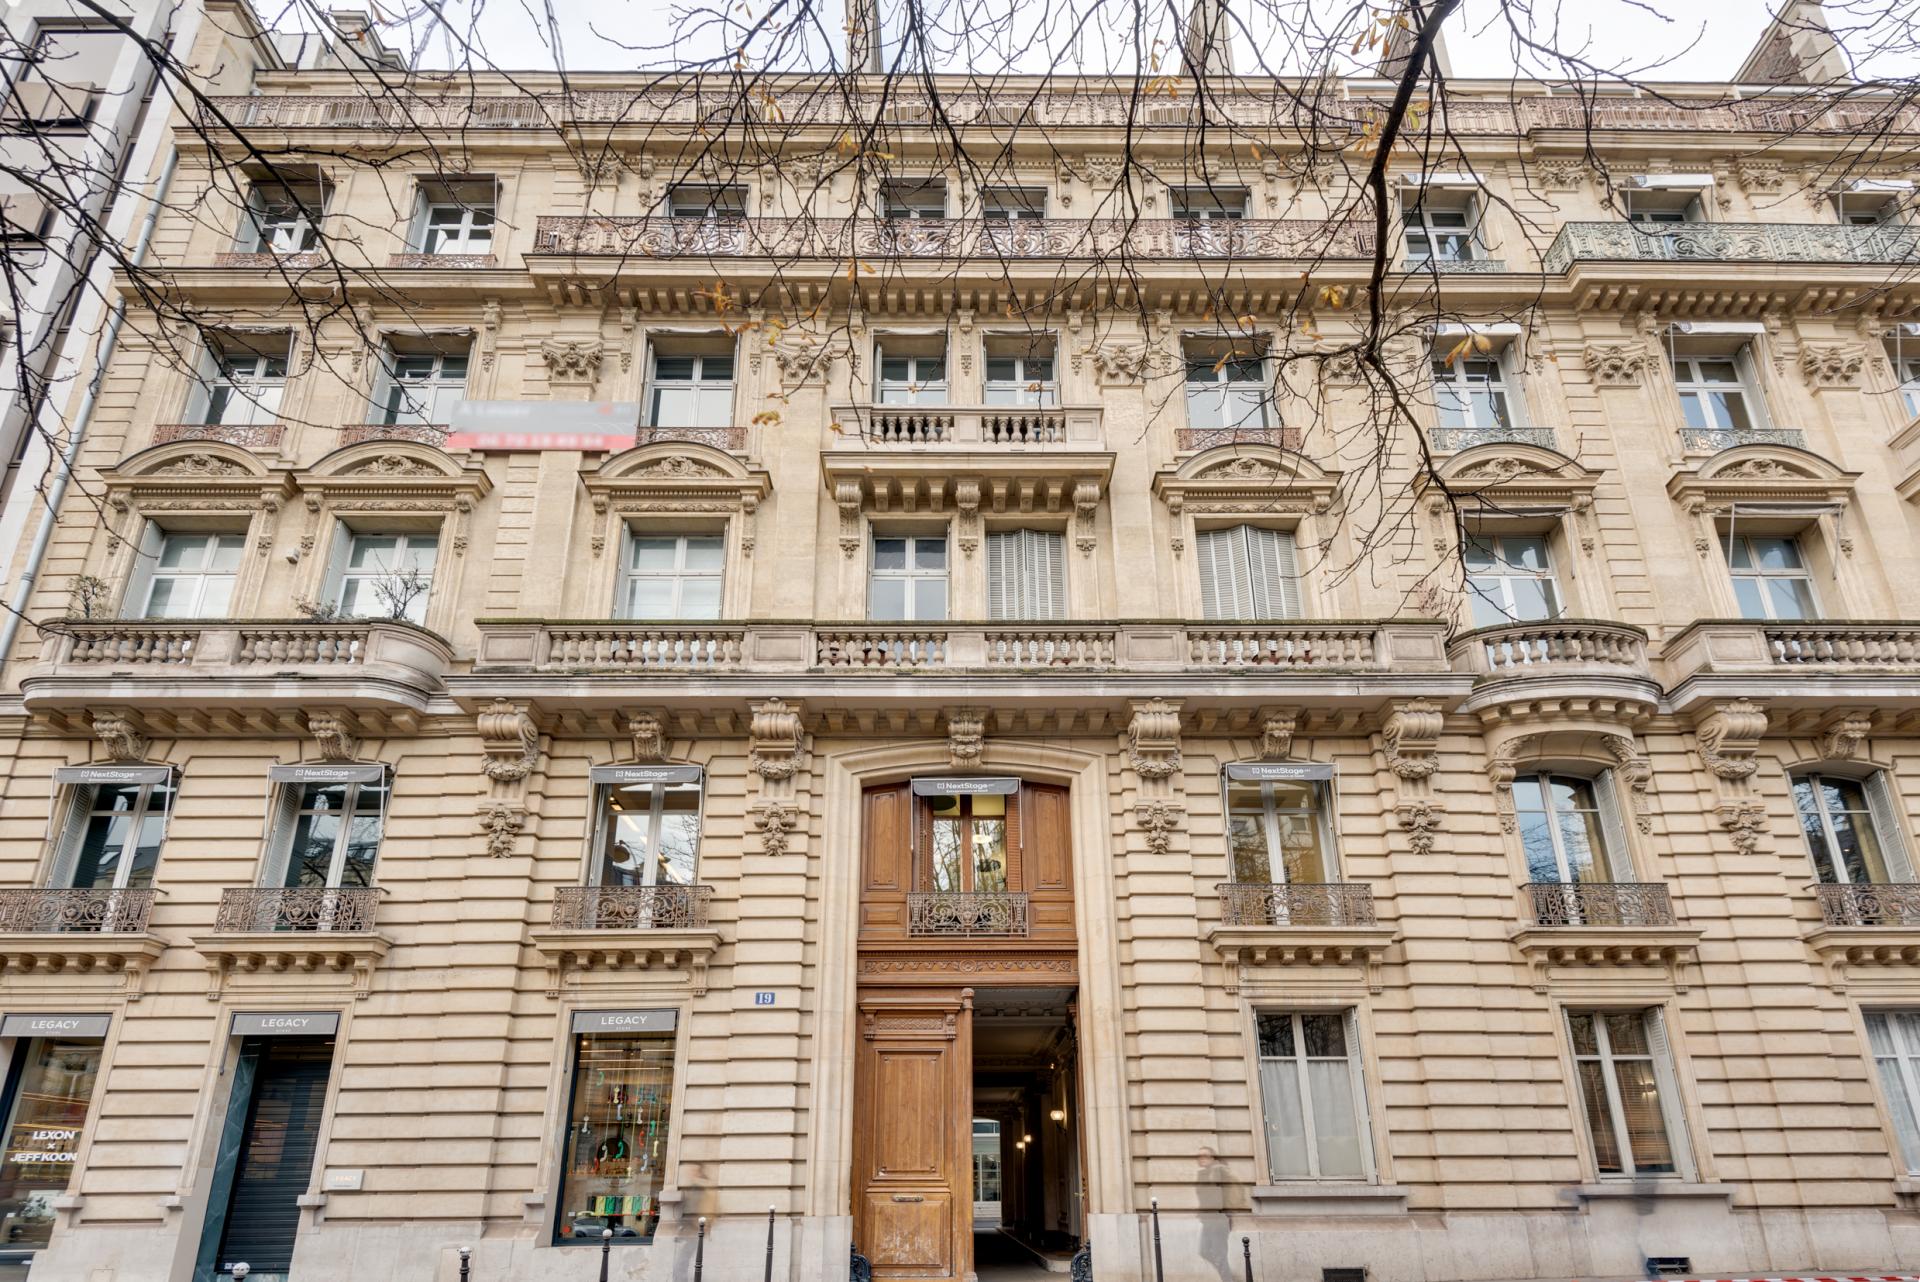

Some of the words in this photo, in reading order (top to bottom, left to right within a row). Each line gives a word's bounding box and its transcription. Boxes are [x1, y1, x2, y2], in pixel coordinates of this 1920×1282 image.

[90, 770, 135, 778] NextStage
[304, 769, 349, 777] NextStage
[624, 770, 668, 778] NextStage
[1261, 767, 1304, 775] NextStage
[946, 782, 988, 790] NextStage
[759, 993, 772, 1004] 19
[31, 1020, 80, 1029] LEGACY
[261, 1018, 309, 1027] LEGACY
[601, 1015, 648, 1025] LEGACY
[32, 1130, 76, 1140] LEXON
[10, 1152, 42, 1162] JEFF
